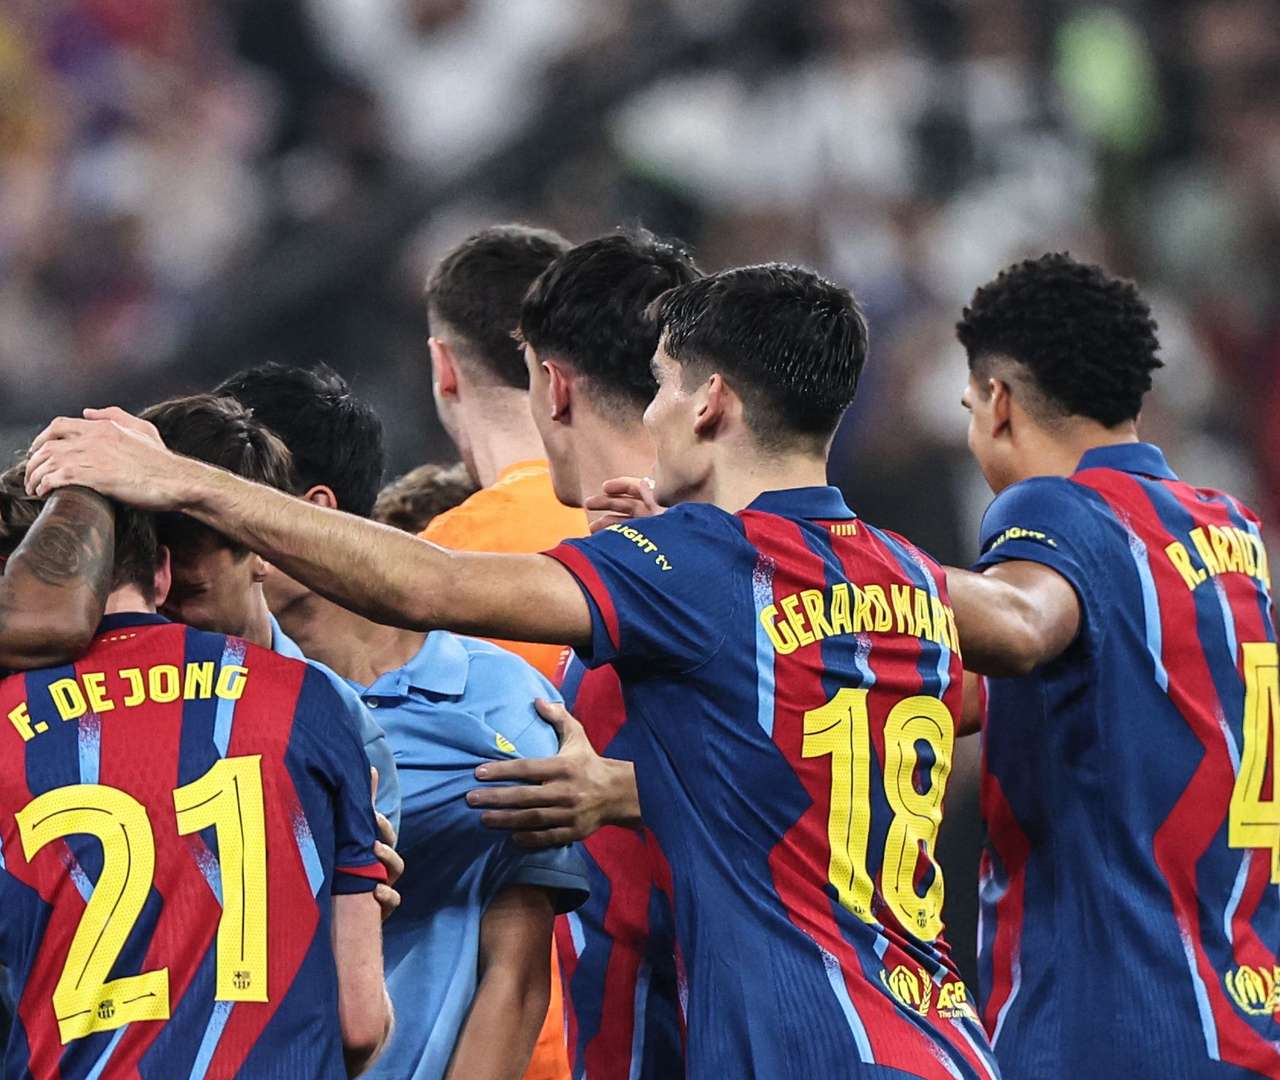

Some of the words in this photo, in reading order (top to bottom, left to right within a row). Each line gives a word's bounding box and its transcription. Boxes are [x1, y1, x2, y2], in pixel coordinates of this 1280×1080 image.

[7, 701, 49, 742] F.
[47, 670, 115, 722] DE
[118, 661, 250, 707] JONG
[759, 583, 892, 655] GERARD
[801, 687, 955, 942] 18
[14, 754, 270, 1045] 21
